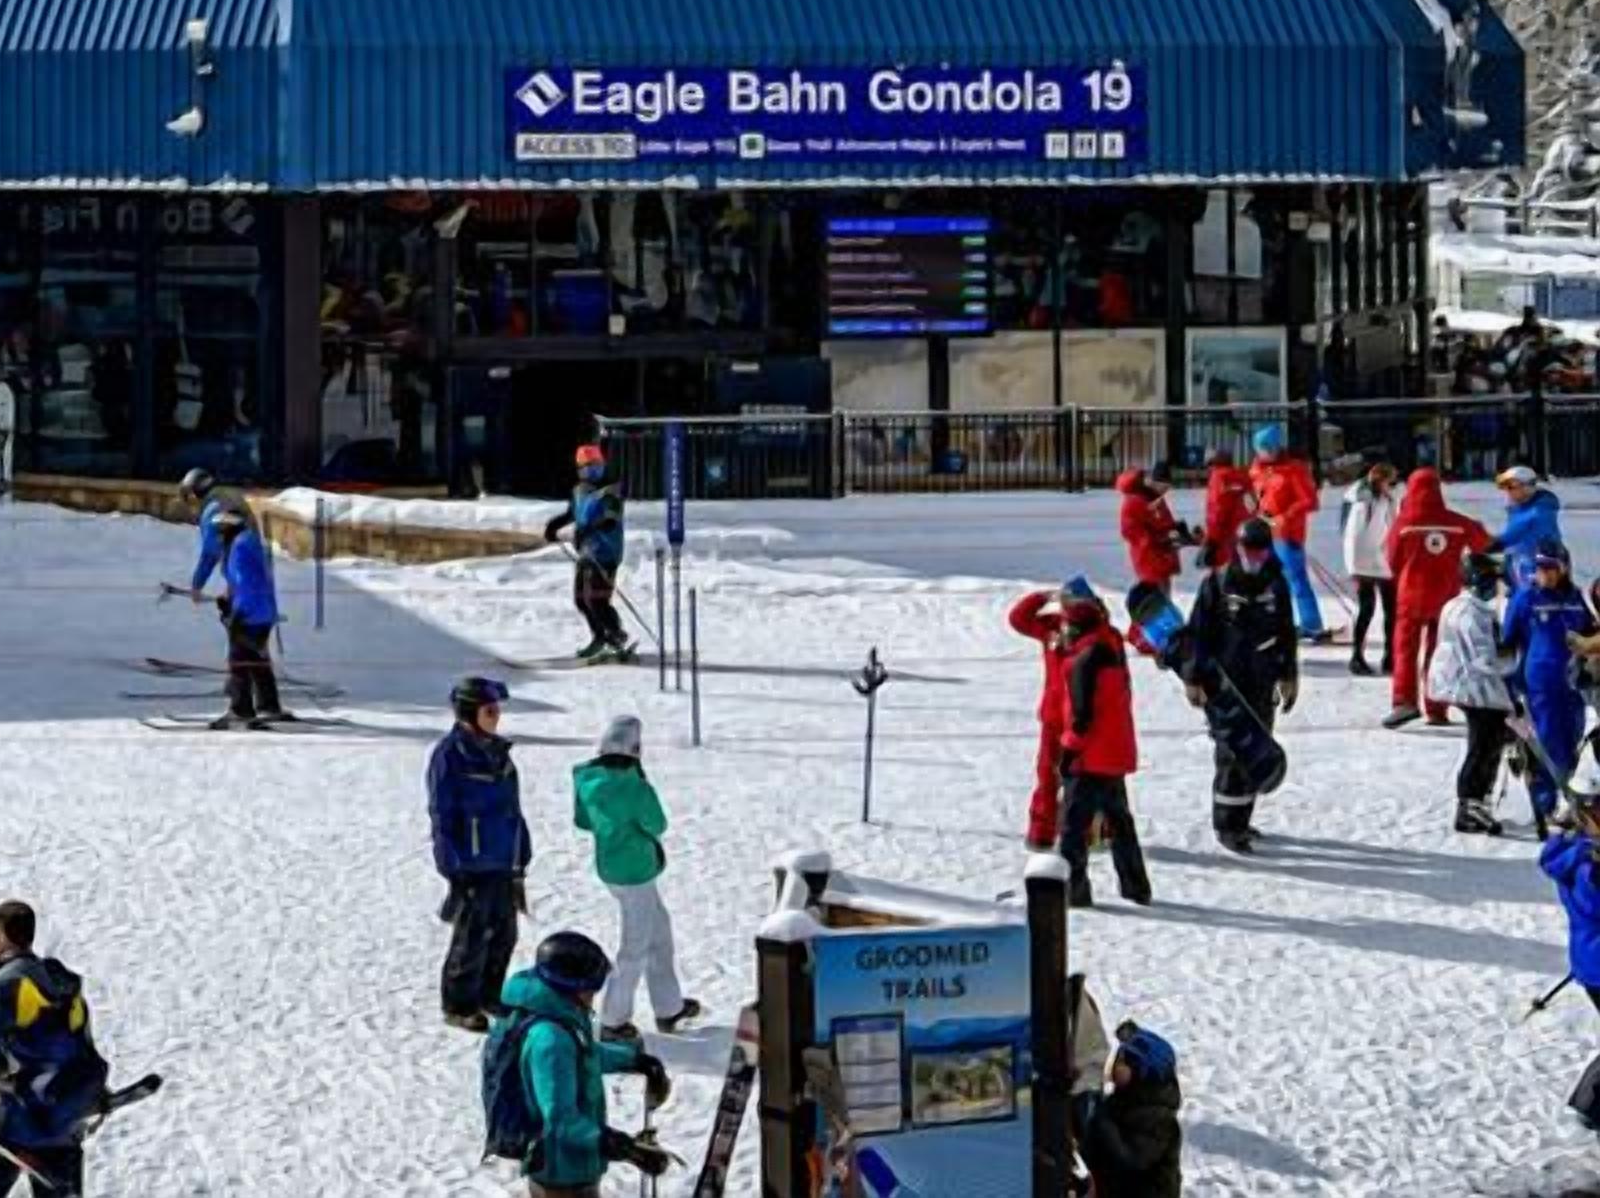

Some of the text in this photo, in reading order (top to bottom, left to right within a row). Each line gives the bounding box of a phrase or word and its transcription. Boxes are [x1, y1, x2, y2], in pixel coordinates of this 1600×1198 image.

[573, 70, 1132, 122] Eagle Bahn Gondola 19
[522, 136, 597, 155] ACCESS
[856, 941, 988, 970] GROOMED
[881, 974, 967, 1002] TRAILS
